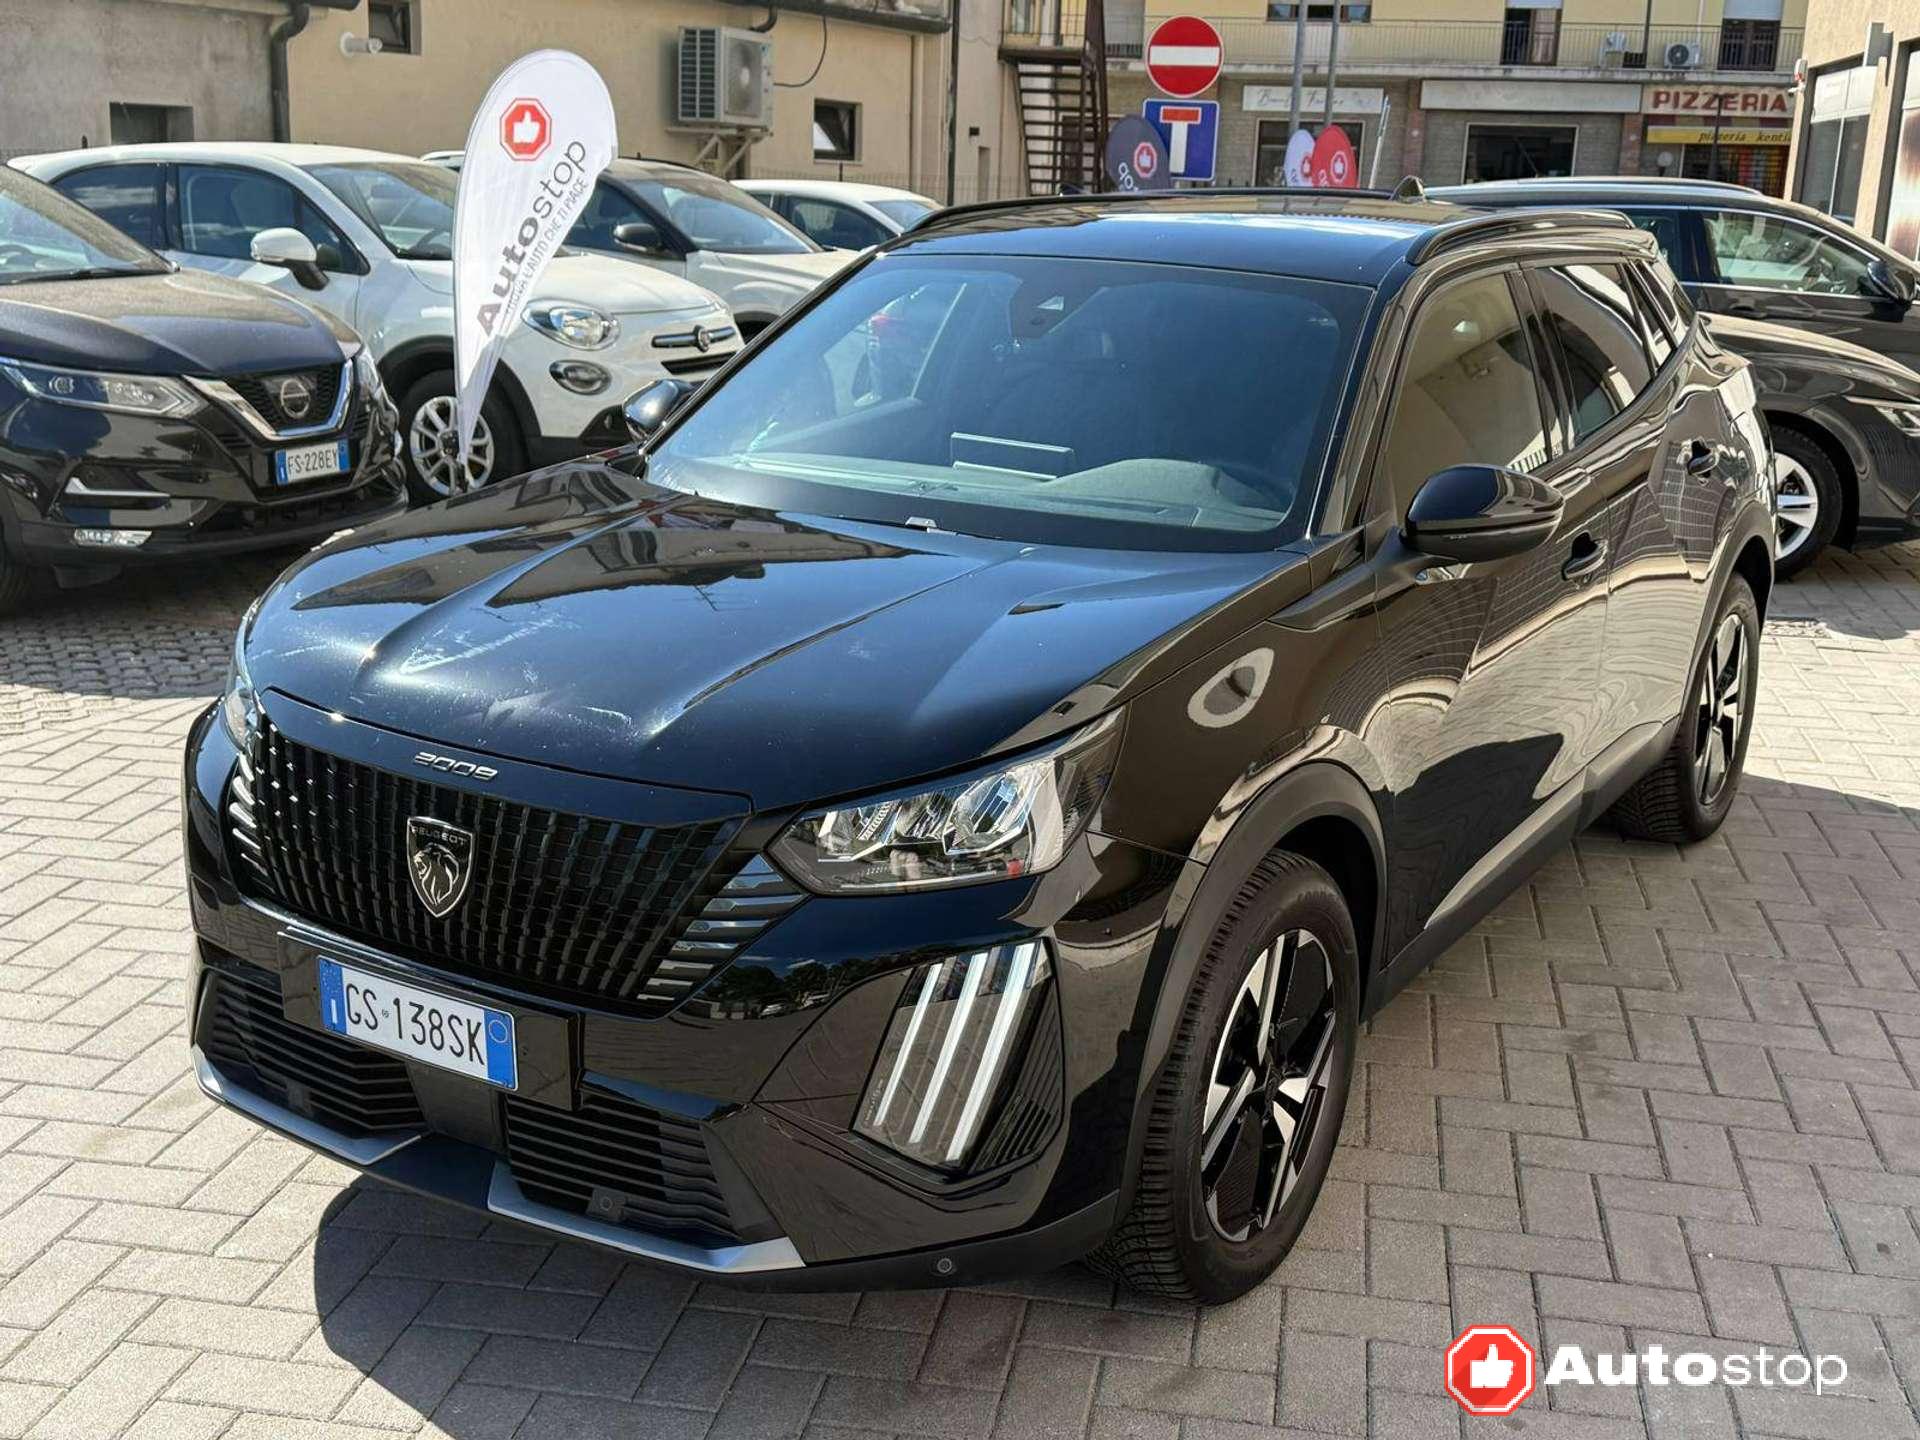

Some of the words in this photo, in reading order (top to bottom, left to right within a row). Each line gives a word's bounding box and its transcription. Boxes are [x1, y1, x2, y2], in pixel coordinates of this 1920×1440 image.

[1652, 90, 1788, 112] PIZZERIA
[565, 177, 589, 211] PIACE
[477, 141, 586, 336] Autostop
[414, 751, 498, 781] 2008
[412, 825, 467, 846] PEUGEOT
